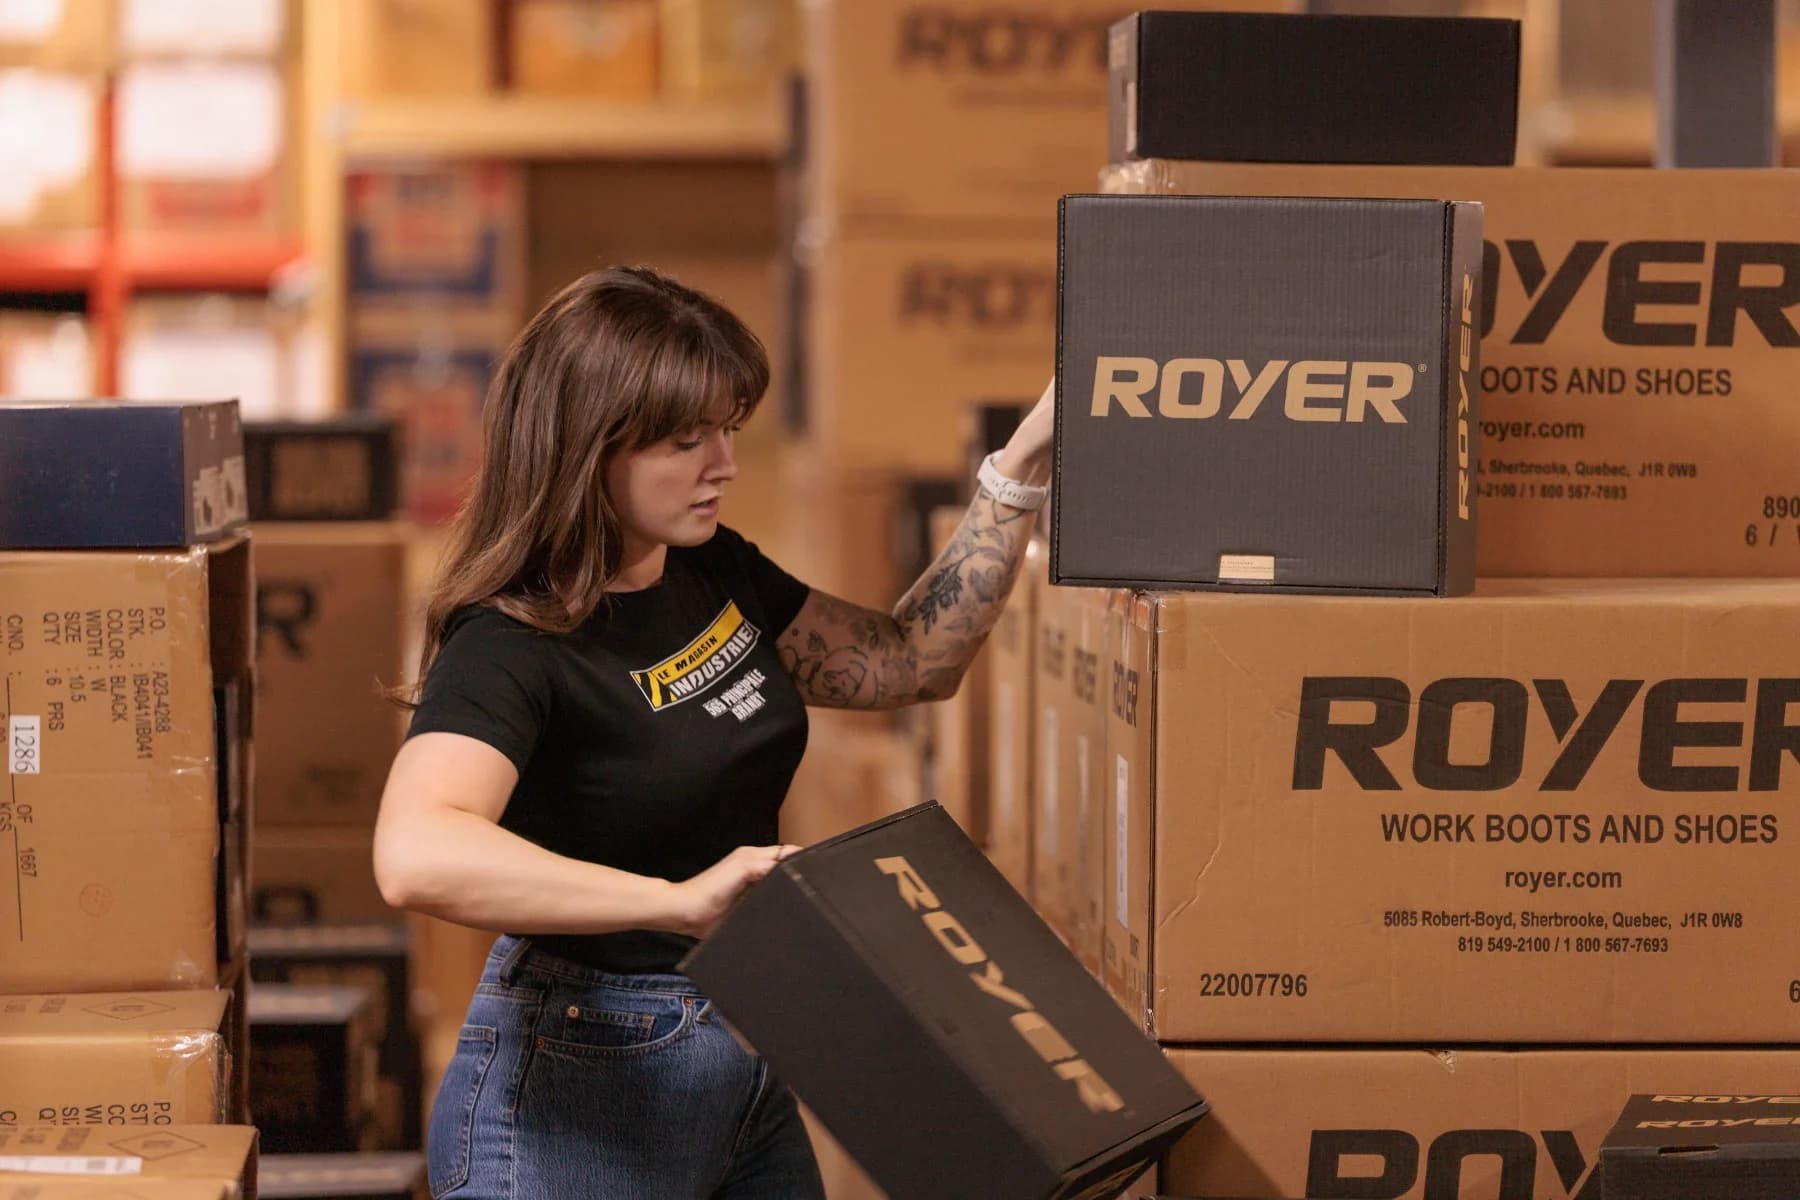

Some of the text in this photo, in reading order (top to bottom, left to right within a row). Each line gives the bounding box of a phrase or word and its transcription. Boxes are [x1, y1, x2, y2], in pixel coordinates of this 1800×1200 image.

[1090, 356, 1414, 423] ROYER
[1566, 368, 1626, 394] AND
[1635, 368, 1733, 395] SHOES
[1458, 273, 1472, 520] ROYER
[1575, 462, 1631, 478] Quebec,
[1638, 464, 1664, 477] J1R
[1530, 485, 1535, 497] 1
[1745, 524, 1757, 546] 6
[64, 610, 82, 643] SIZE
[86, 609, 103, 657] WIDTH
[128, 608, 145, 640] STK.
[149, 607, 166, 634] P.O.
[658, 635, 718, 680] LE MAGASIN
[90, 677, 106, 692] W
[110, 675, 128, 723] BLACK
[48, 702, 64, 731] PRS
[732, 690, 766, 721] GRANBY
[14, 725, 35, 773] 1286
[16, 804, 33, 824] OF
[1381, 813, 1778, 844] WORK BOOTS AND SHOES
[20, 848, 37, 878] 1667
[1504, 870, 1622, 893] royer.com
[1383, 910, 1743, 930] 5085 Robert-Boyd, Sherbrooke, Quebec, J1R 0W8
[1458, 936, 1483, 952] 819
[1487, 936, 1550, 952] 549-2100
[1563, 938, 1570, 952] 1
[1576, 938, 1600, 952] 800
[1605, 938, 1669, 952] 567-7693
[873, 856, 1125, 1113] ROYER
[1199, 973, 1308, 998] 22007796
[1636, 1117, 1800, 1128] ROYE
